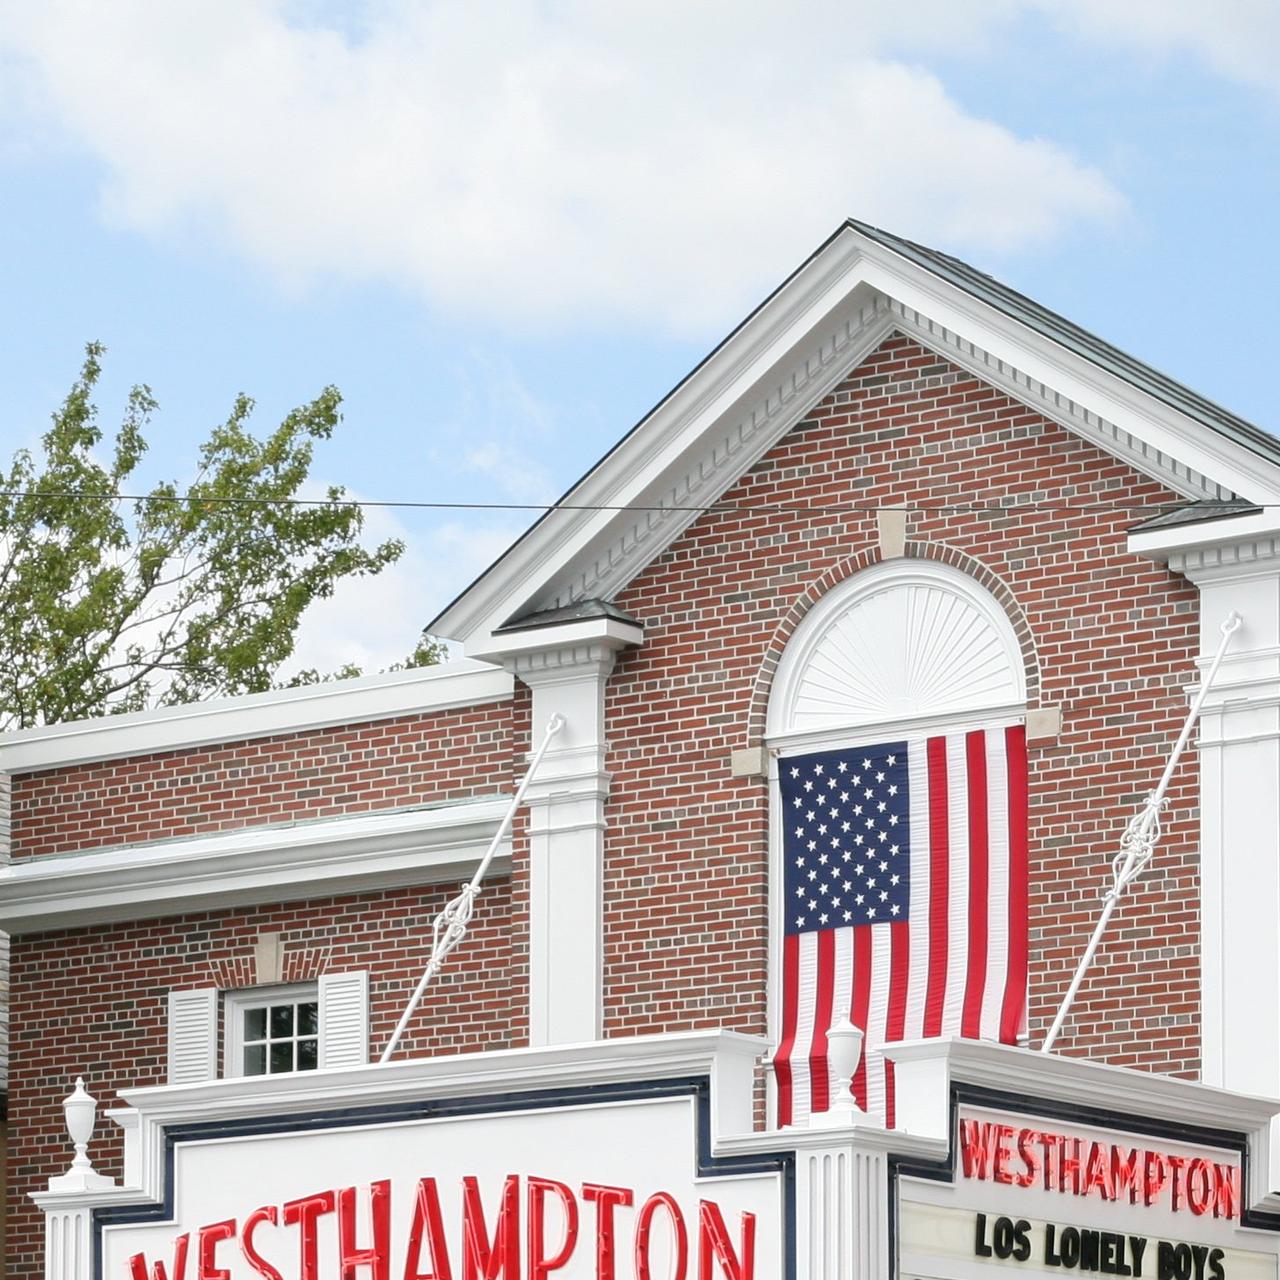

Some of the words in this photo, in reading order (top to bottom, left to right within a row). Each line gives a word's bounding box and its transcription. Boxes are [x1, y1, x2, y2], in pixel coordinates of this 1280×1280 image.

[959, 1118, 1241, 1220] WESTHAMPTON
[975, 1213, 1032, 1262] LOS
[1045, 1223, 1147, 1278] LONELY
